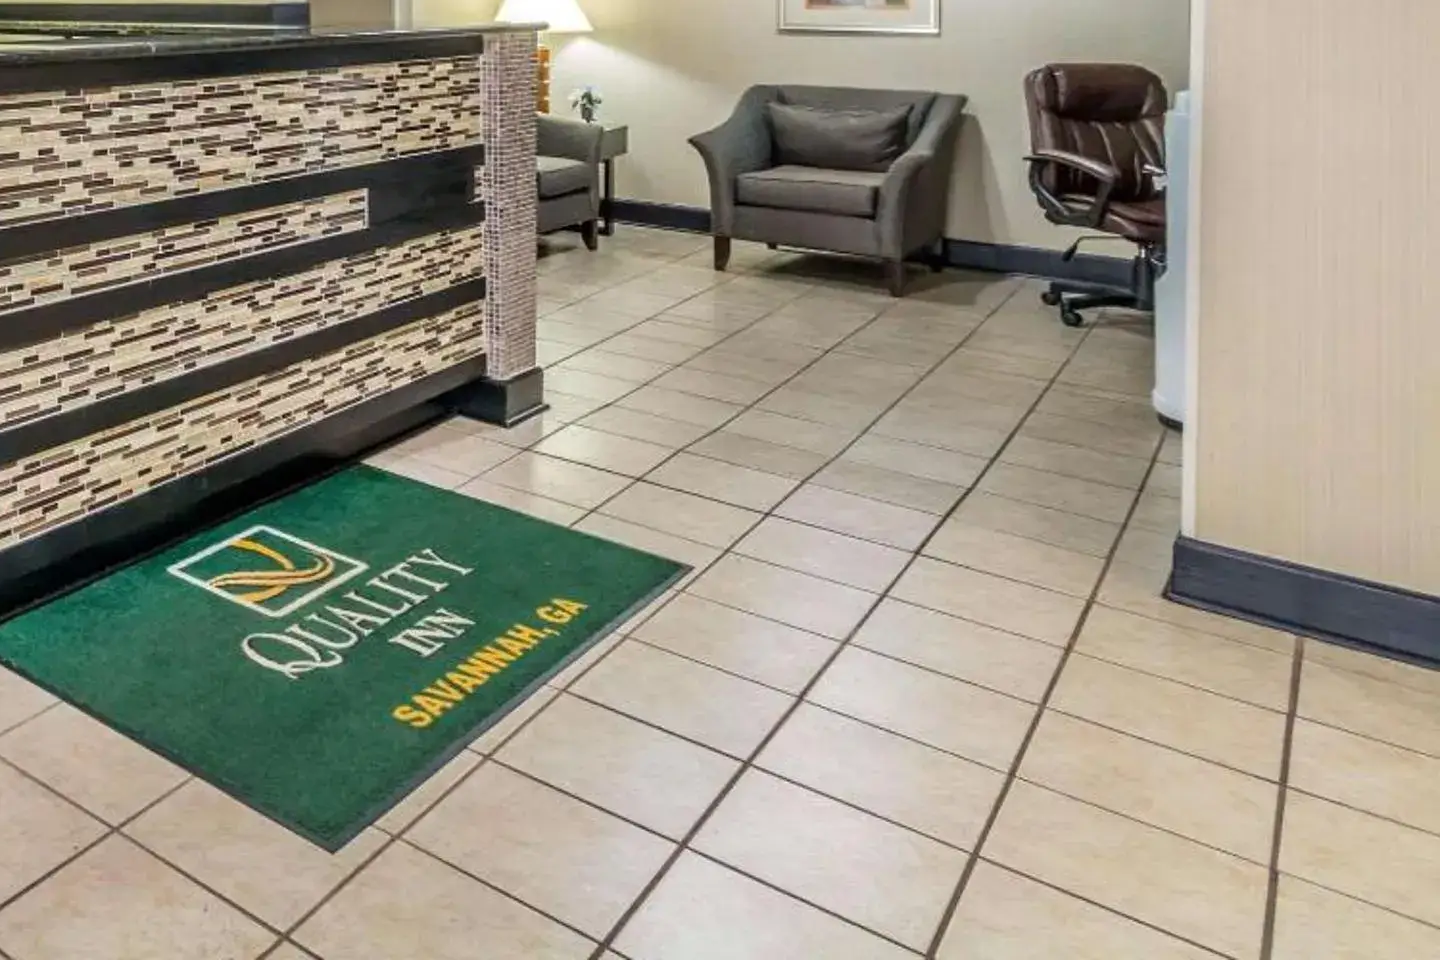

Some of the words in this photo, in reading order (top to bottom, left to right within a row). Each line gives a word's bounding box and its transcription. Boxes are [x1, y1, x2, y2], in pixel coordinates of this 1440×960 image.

[241, 548, 474, 678] QUALITY
[388, 607, 476, 657] INN
[392, 624, 559, 728] SAVANNAH,
[535, 597, 588, 625] GA
